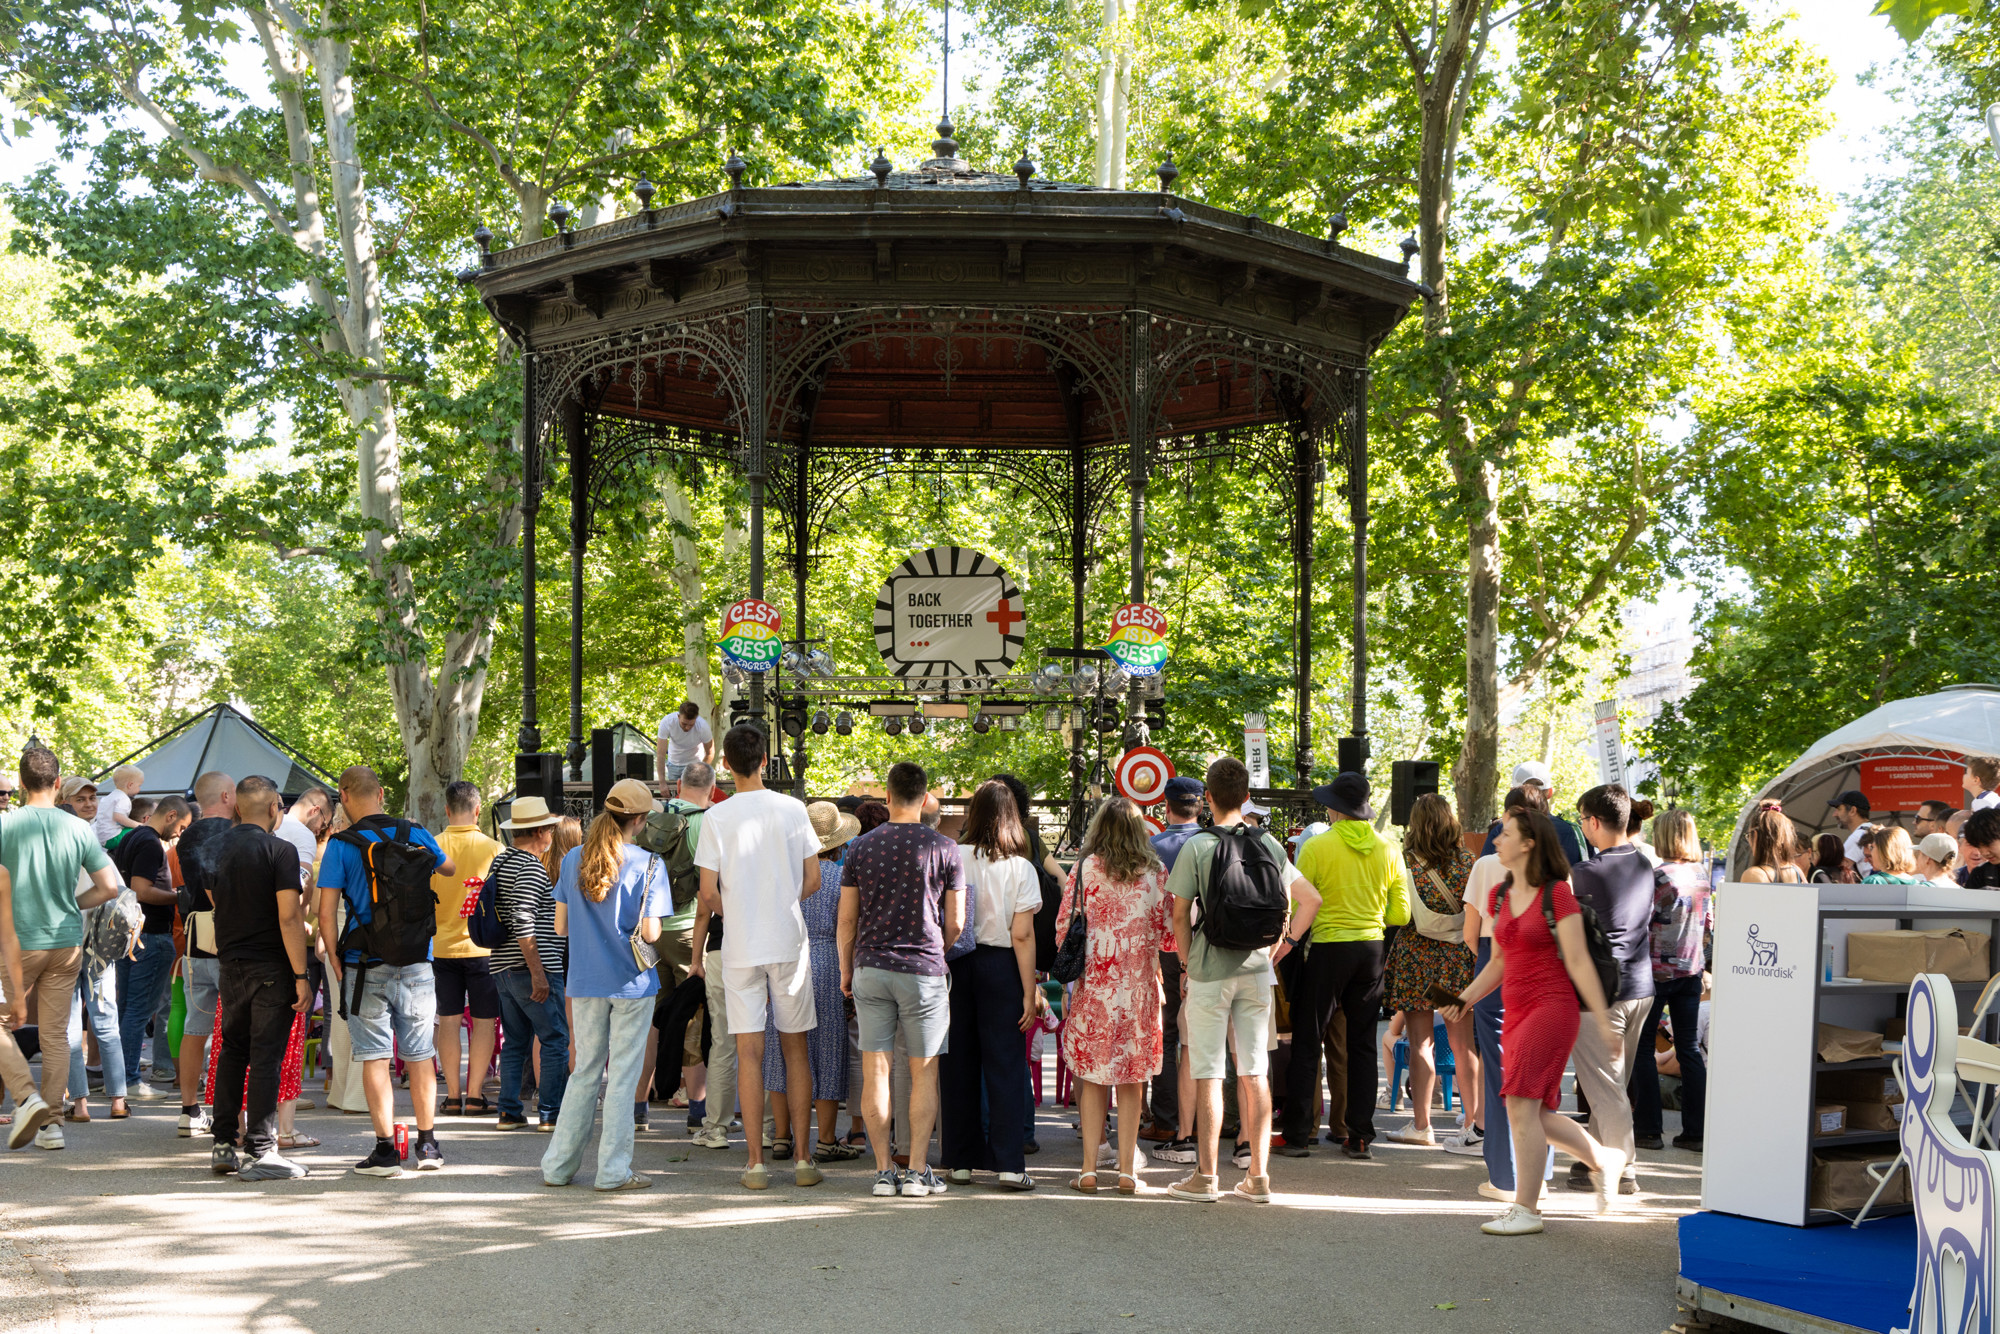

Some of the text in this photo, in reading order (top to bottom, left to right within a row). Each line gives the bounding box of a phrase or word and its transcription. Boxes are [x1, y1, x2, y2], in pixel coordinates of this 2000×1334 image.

[908, 593, 942, 607] BACK
[730, 601, 779, 625] CEST
[908, 613, 973, 628] TOGETHER
[1116, 606, 1165, 630] CEST
[729, 637, 778, 660] BEST
[1115, 641, 1163, 665] BEST
[735, 657, 772, 671] ZAGREB
[1121, 661, 1157, 676] ZAGREB
[1874, 764, 1915, 772] ALERGOLOŠKA
[1732, 965, 1756, 976] novo
